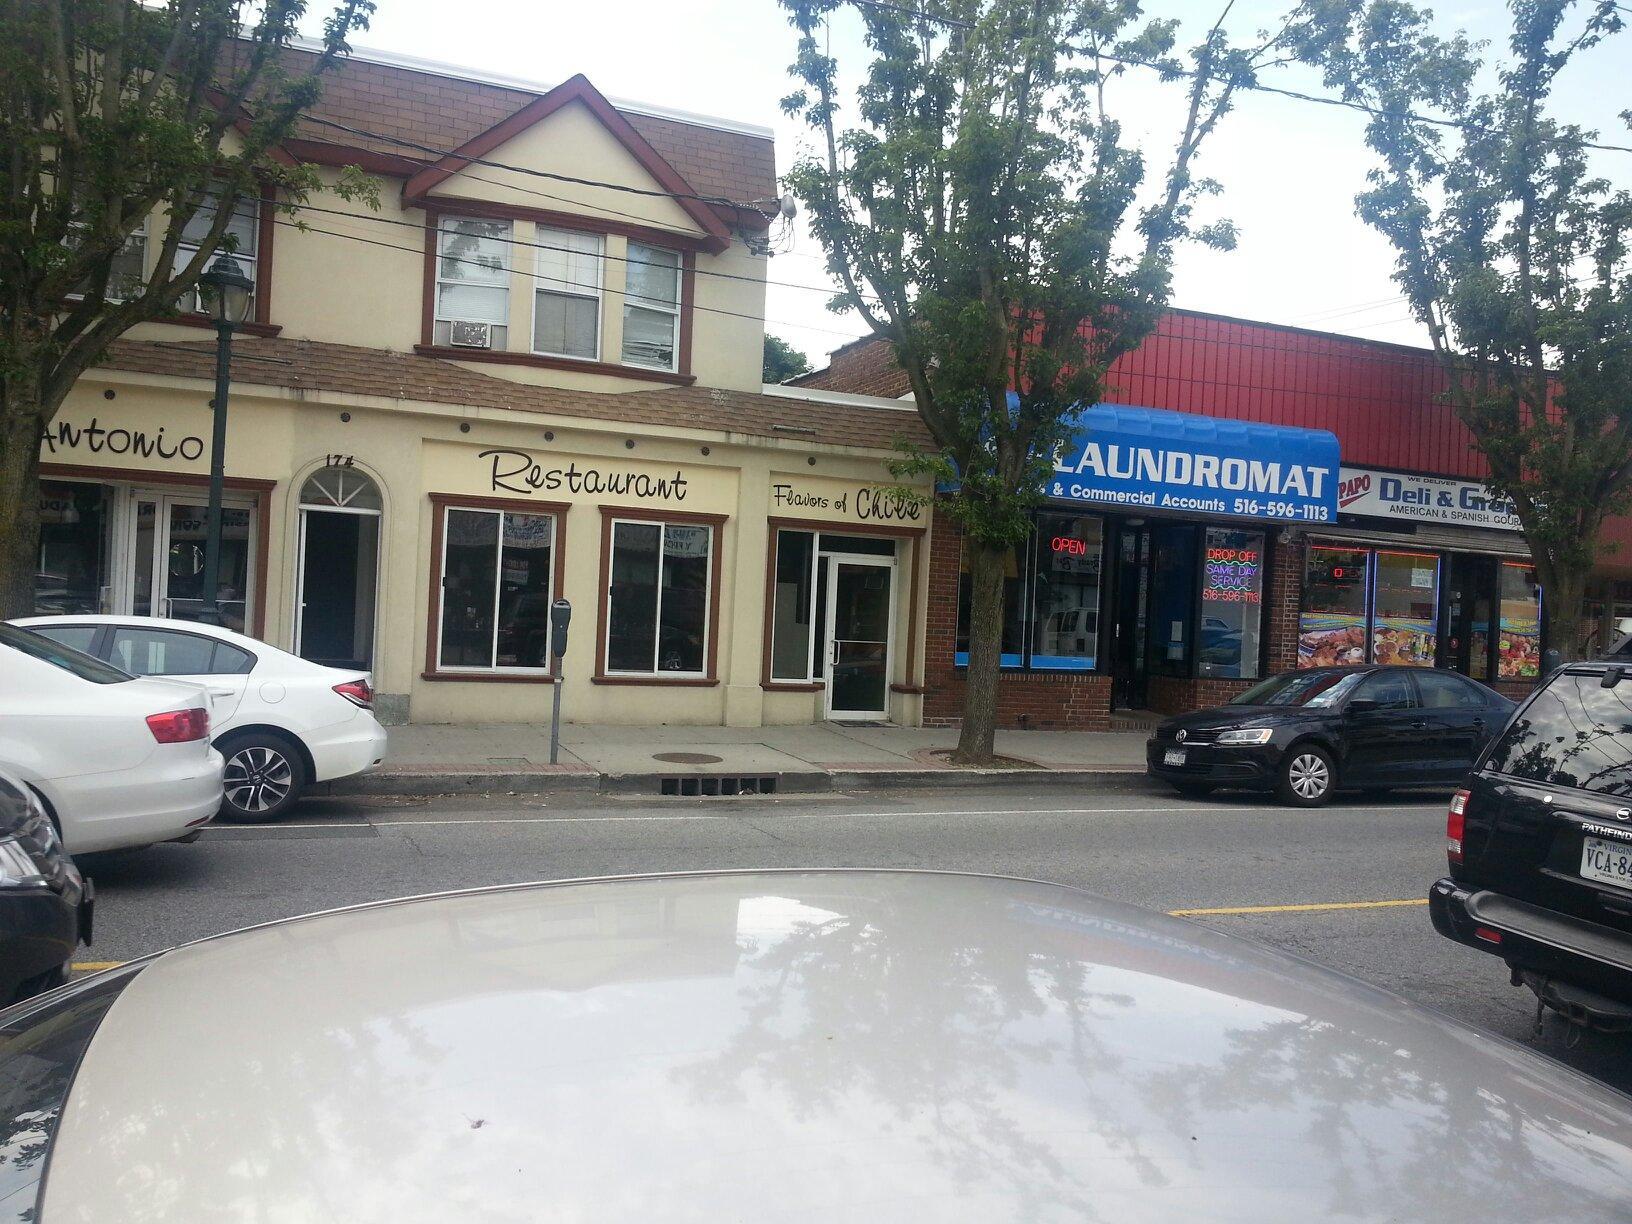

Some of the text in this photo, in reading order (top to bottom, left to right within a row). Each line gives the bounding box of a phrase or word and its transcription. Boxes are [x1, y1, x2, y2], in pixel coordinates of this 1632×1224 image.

[326, 454, 354, 468] 174
[1052, 438, 1329, 499] LAUNDROMAT
[477, 448, 688, 501] Restaurant
[1423, 478, 1457, 486] DELIVER
[1338, 474, 1371, 499] PAPO
[1379, 477, 1431, 506] Deli
[1437, 490, 1454, 508] &
[773, 484, 829, 509] Flavors
[834, 492, 847, 513] of
[1053, 482, 1064, 496] &
[1070, 483, 1156, 506] Commercial
[1161, 492, 1226, 512] Accounts
[1233, 498, 1329, 521] 516-596-1113
[1389, 504, 1439, 519] AMERICAN
[1441, 510, 1448, 519] &
[1451, 511, 1490, 523] SPANISH
[1052, 537, 1086, 555] OPEN
[1207, 549, 1257, 562] DROP OFF
[1206, 563, 1257, 576] SAME DAY
[1211, 575, 1252, 587] SERVICE
